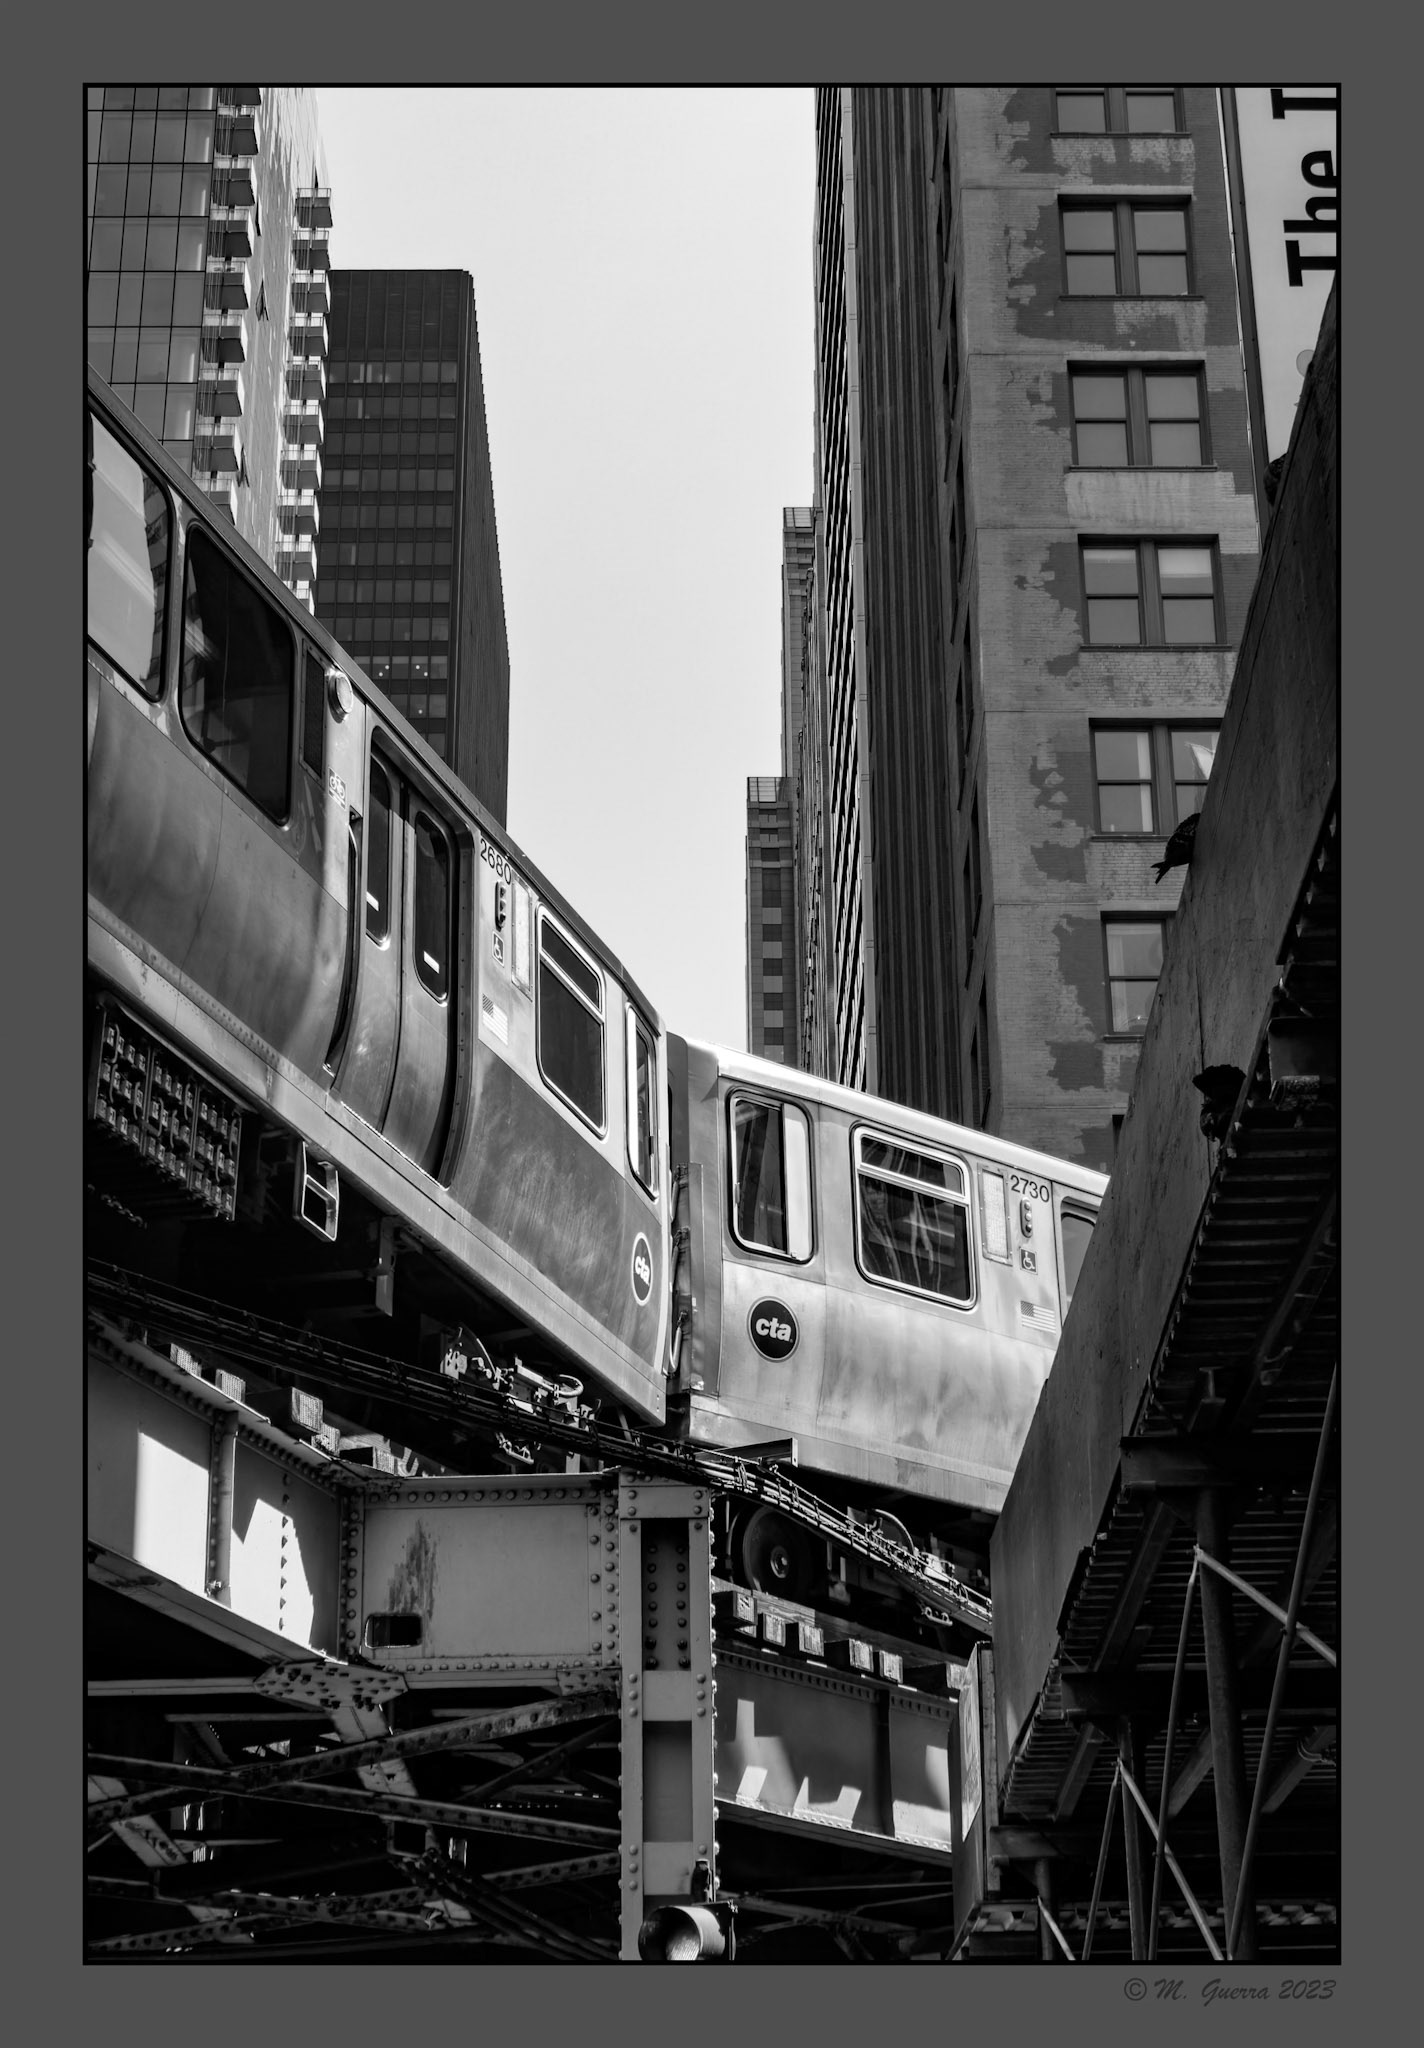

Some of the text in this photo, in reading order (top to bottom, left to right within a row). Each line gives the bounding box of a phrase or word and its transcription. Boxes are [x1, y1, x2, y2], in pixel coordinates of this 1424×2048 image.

[1282, 150, 1337, 287] The
[480, 838, 511, 885] 2680
[1010, 1174, 1049, 1202] 2730
[635, 1256, 649, 1285] cta
[756, 1317, 791, 1341] cta
